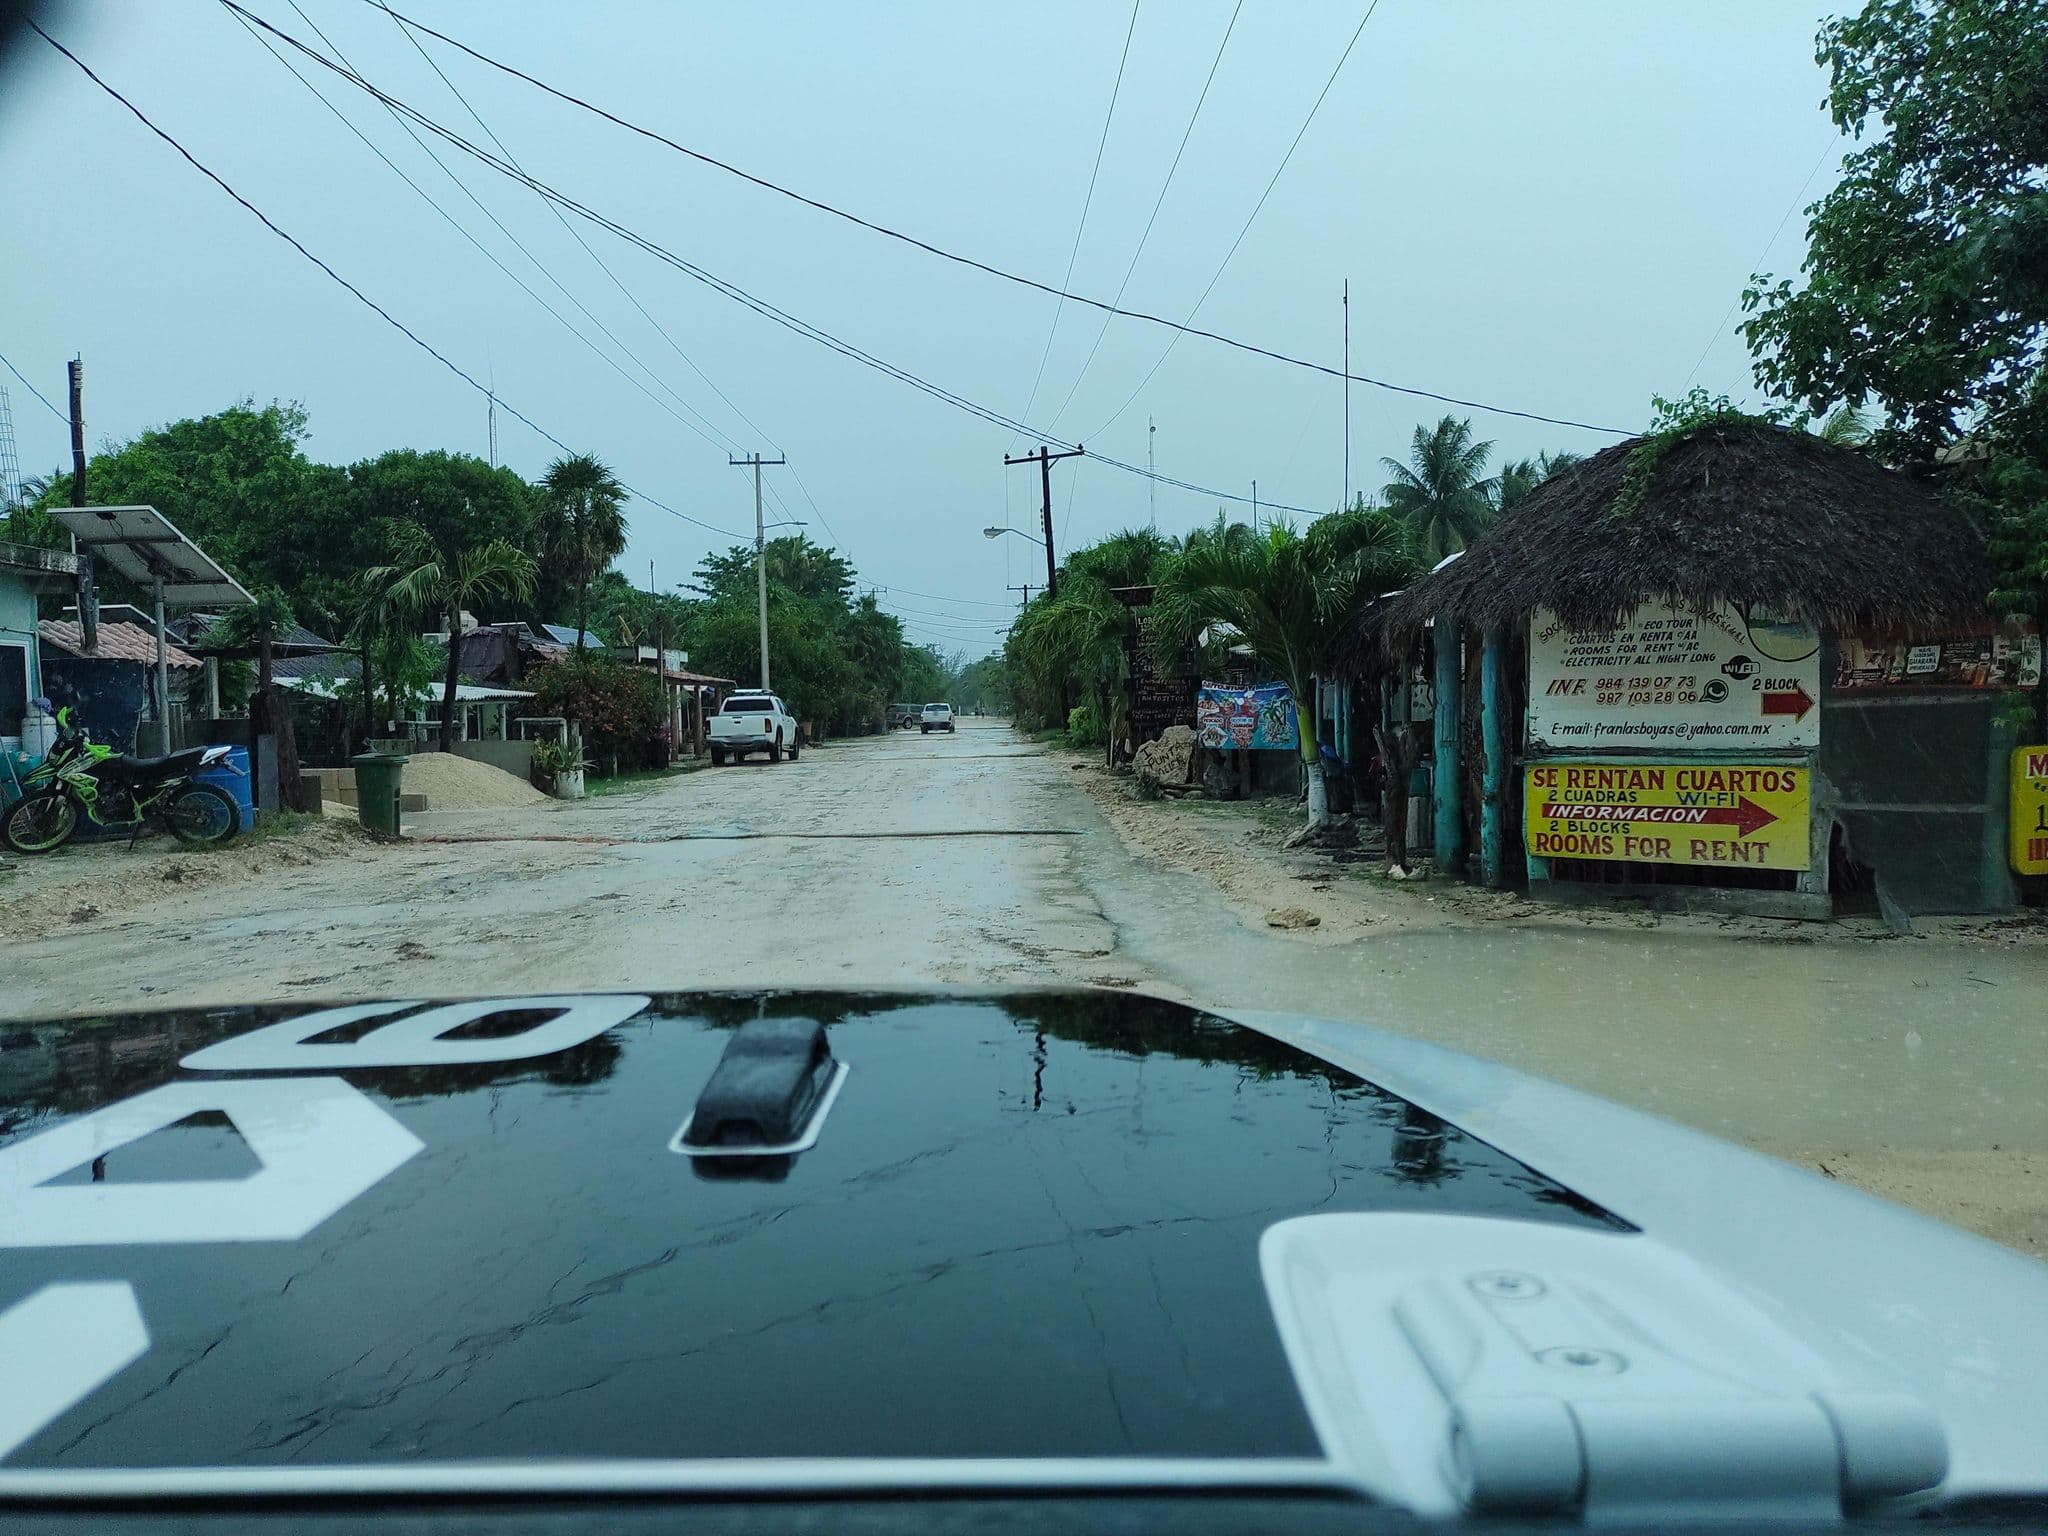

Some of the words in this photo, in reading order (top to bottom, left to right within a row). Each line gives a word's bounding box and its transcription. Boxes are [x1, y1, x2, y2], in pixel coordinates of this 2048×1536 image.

[1644, 621, 1663, 630] ECO
[1667, 619, 1693, 629] TOUR
[1569, 634, 1616, 645] CUARTOS
[1620, 633, 1635, 643] EN
[1639, 632, 1673, 642] RENTA
[1569, 645, 1612, 656] ROOMS
[1616, 645, 1638, 653] FOR
[1644, 643, 1675, 653] RENT
[1565, 656, 1632, 667] ELECTRICITY
[1633, 655, 1651, 665] ALL
[1656, 654, 1688, 664] NIGHT
[1690, 653, 1716, 663] LONG
[1545, 679, 1588, 696] INF.
[1595, 678, 1622, 689] 984
[1628, 677, 1650, 689] 139
[1653, 676, 1674, 689] 07
[1677, 676, 1696, 688] 73
[1751, 679, 1762, 690] 2
[1764, 678, 1801, 690] BLOCK
[1596, 692, 1623, 705] 987
[1628, 692, 1651, 704] 103
[1654, 691, 1674, 704] 28
[1677, 691, 1697, 703] 06
[1551, 722, 1592, 735] E-mail:
[1594, 721, 1772, 740] franlasboyas@yahoo.com.mx
[1533, 769, 1558, 788] SE
[1567, 769, 1665, 790] RENTAN
[1676, 770, 1796, 793] CUARTOS
[1549, 789, 1558, 801] 2
[1564, 790, 1637, 803] CUADRAS
[1676, 792, 1735, 806] WI-FI
[1549, 805, 1708, 823] INFORMACION
[1550, 820, 1559, 832] 2
[1568, 822, 1631, 834] BLOCKS
[1535, 833, 1614, 855] ROOMS
[1624, 836, 1671, 858] FOR
[1690, 839, 1770, 863] RENT
